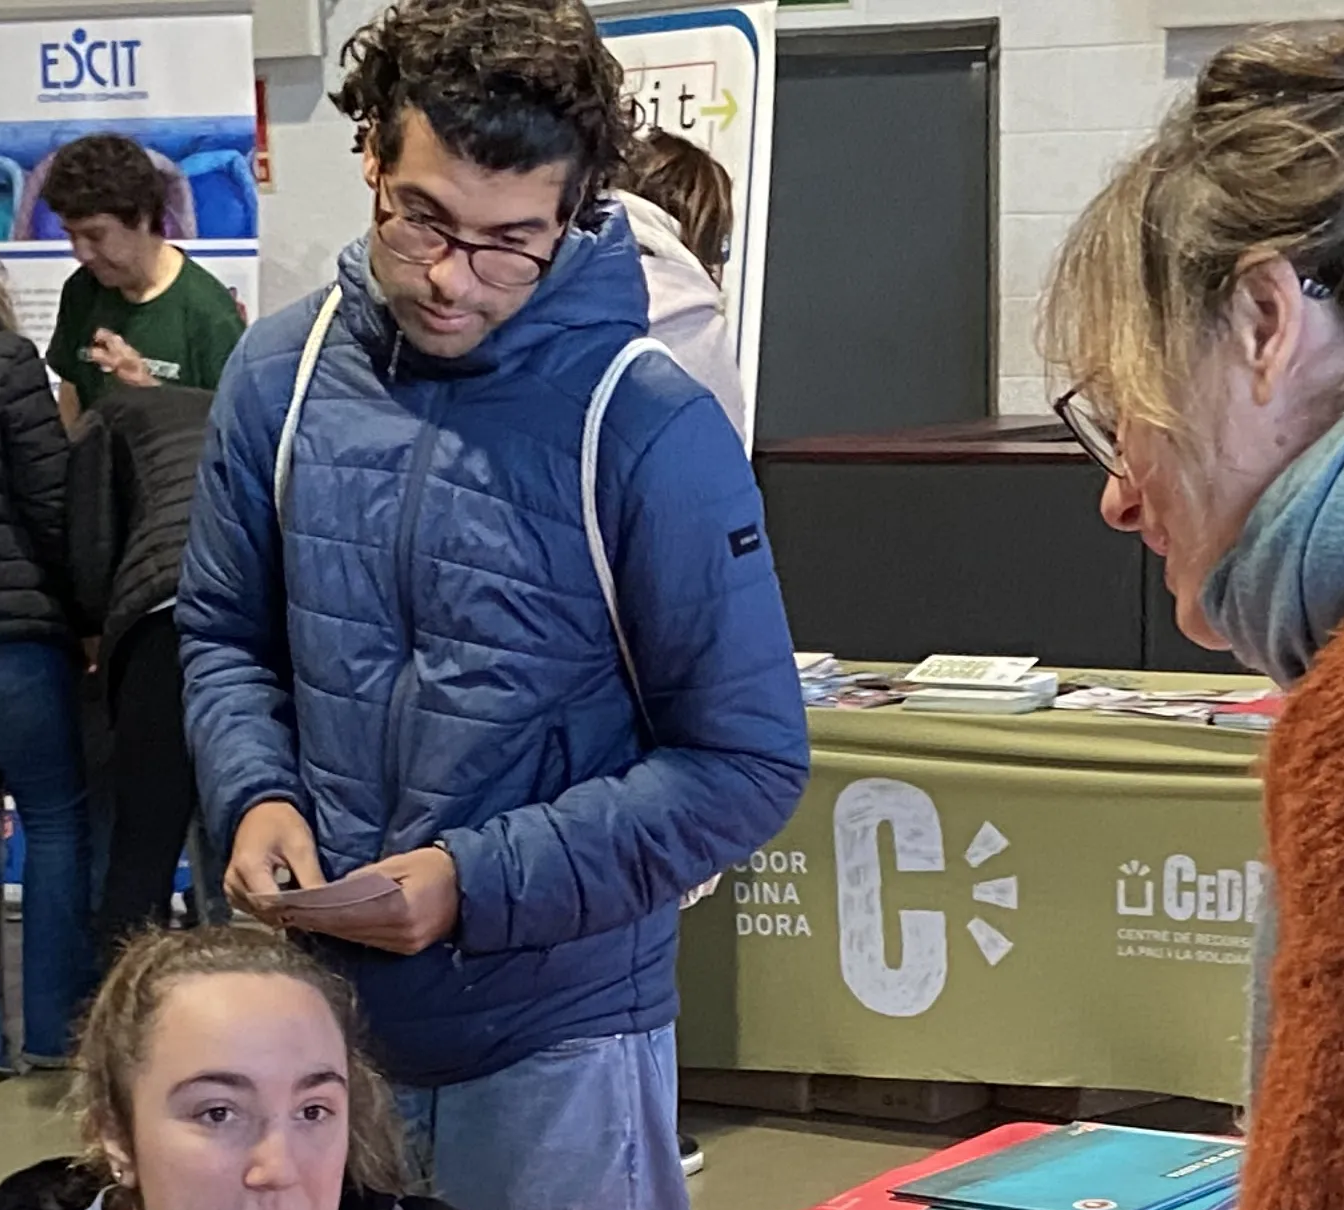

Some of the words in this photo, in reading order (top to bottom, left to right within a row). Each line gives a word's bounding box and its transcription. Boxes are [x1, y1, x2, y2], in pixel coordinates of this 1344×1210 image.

[734, 881, 801, 905] DINA
[736, 913, 812, 937] DORA
[1117, 928, 1171, 942] CENTRE
[1173, 932, 1192, 944] DE
